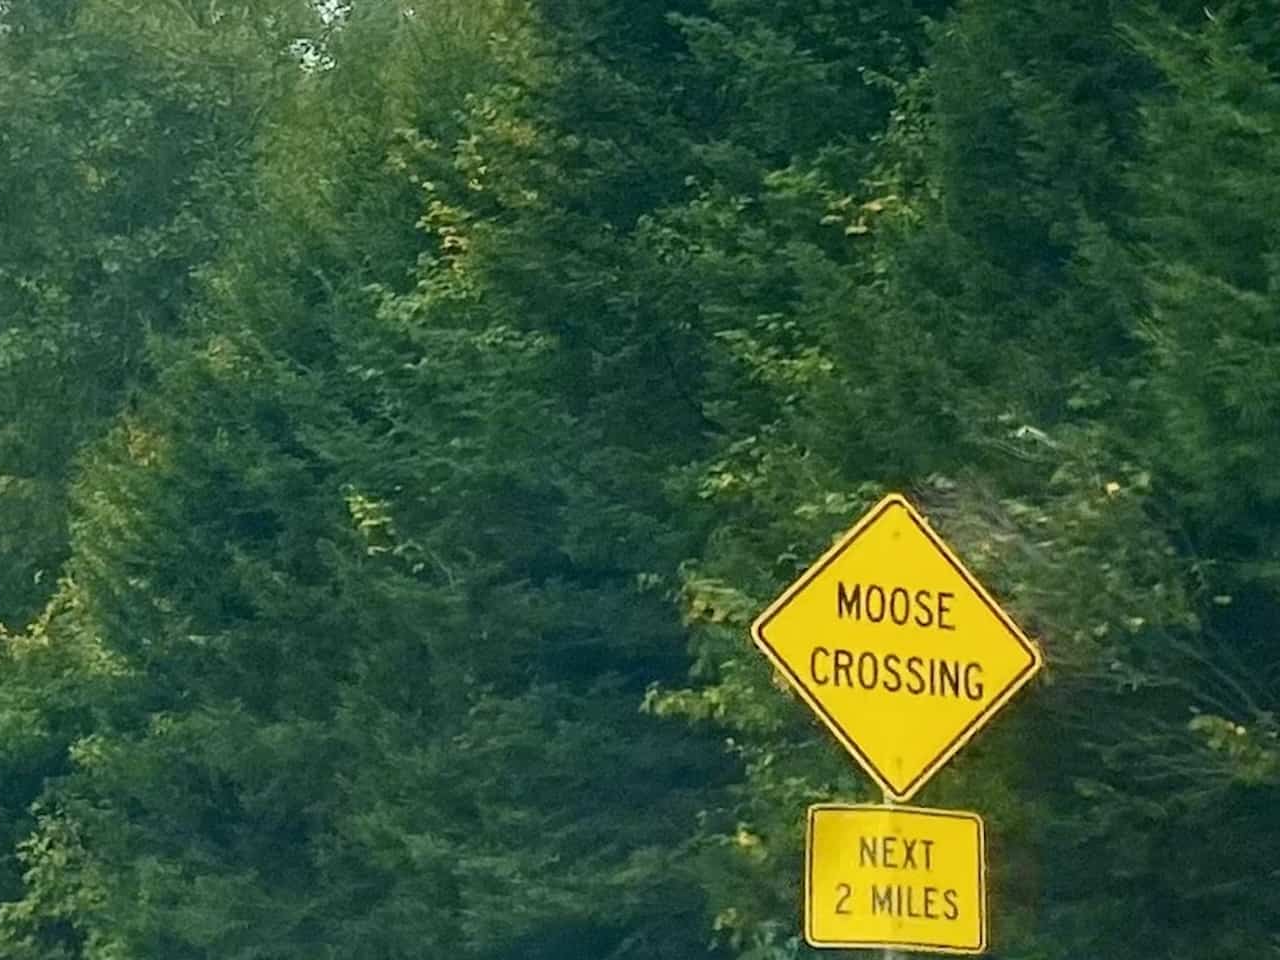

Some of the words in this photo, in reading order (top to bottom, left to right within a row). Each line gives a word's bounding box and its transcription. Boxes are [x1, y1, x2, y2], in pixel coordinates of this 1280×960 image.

[837, 583, 955, 630] MOOSE
[811, 647, 984, 701] CROSSING
[860, 837, 934, 870] NEXT
[836, 884, 852, 914] 2
[873, 885, 959, 920] MILES
